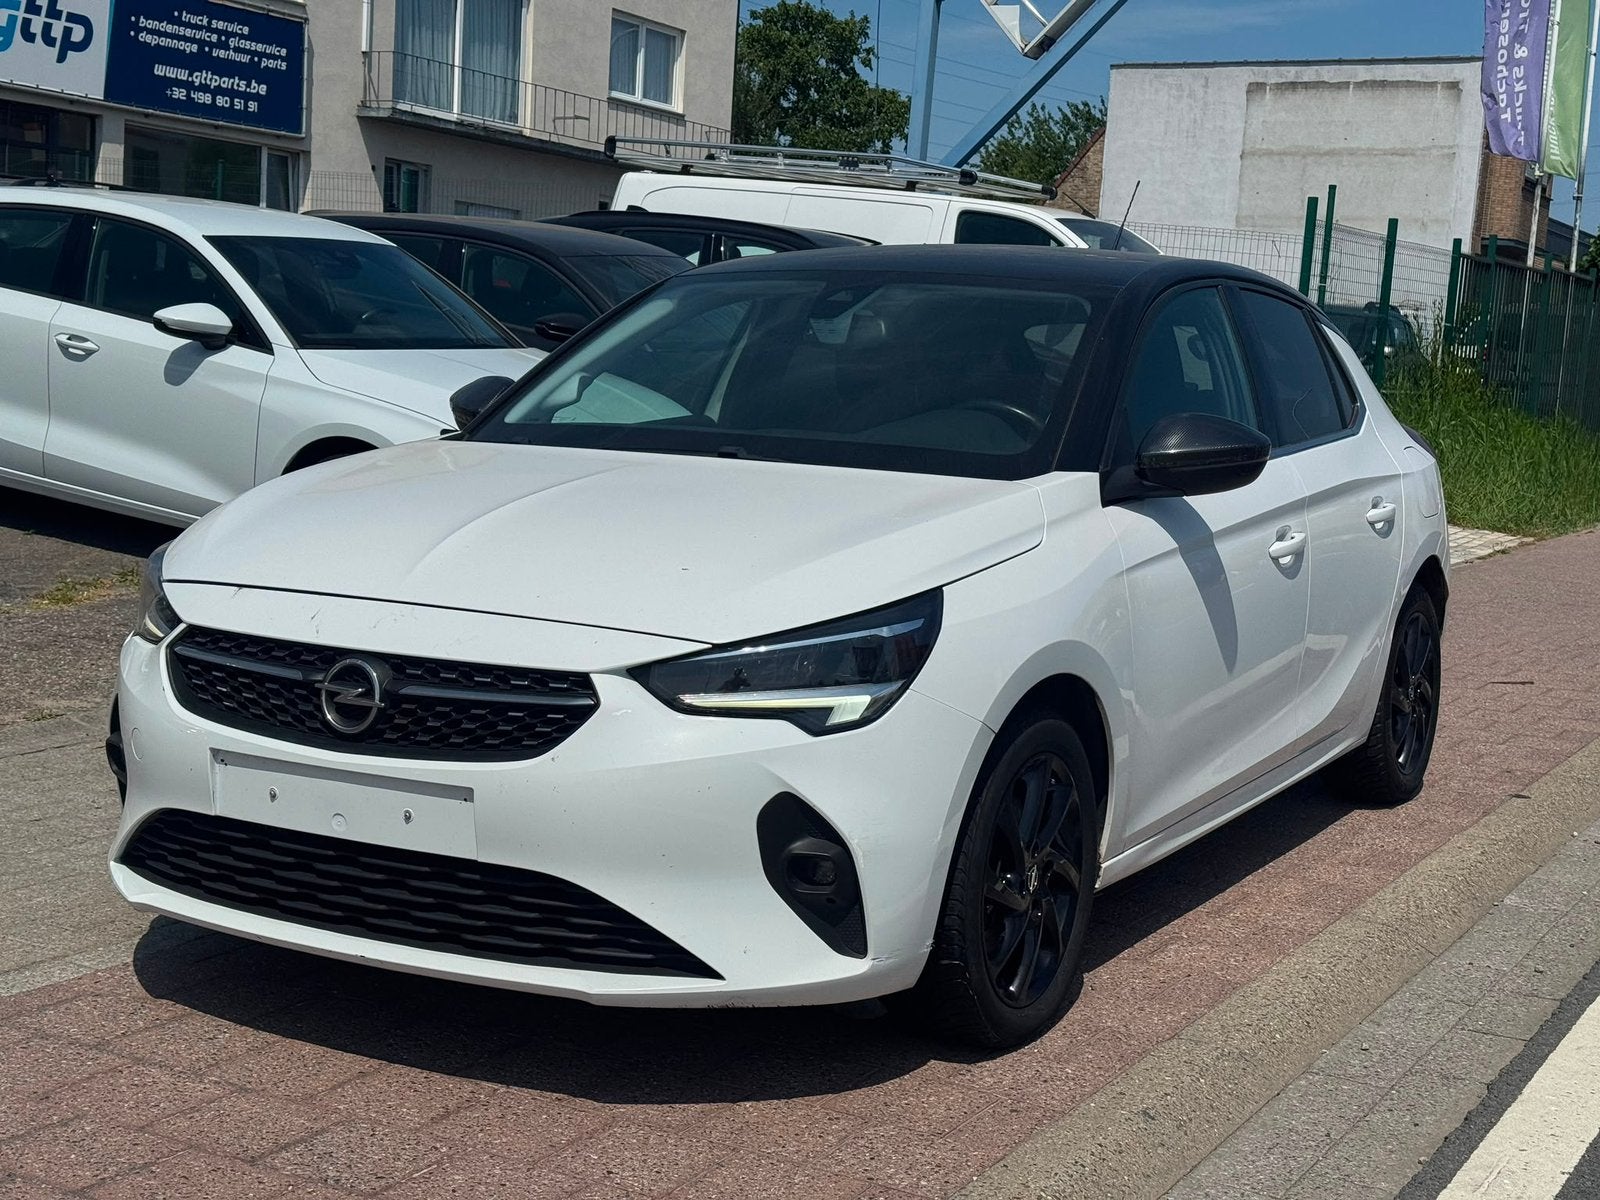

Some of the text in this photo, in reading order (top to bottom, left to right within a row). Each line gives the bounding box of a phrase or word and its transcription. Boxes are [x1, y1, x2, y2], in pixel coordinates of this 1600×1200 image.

[139, 15, 287, 57] bandenservice glasservice
[181, 10, 249, 35] truck service
[138, 31, 287, 70] depannage verhuur parts
[153, 63, 267, 95] www.gttparts.be
[165, 87, 258, 112] +32 498 80 51 91
